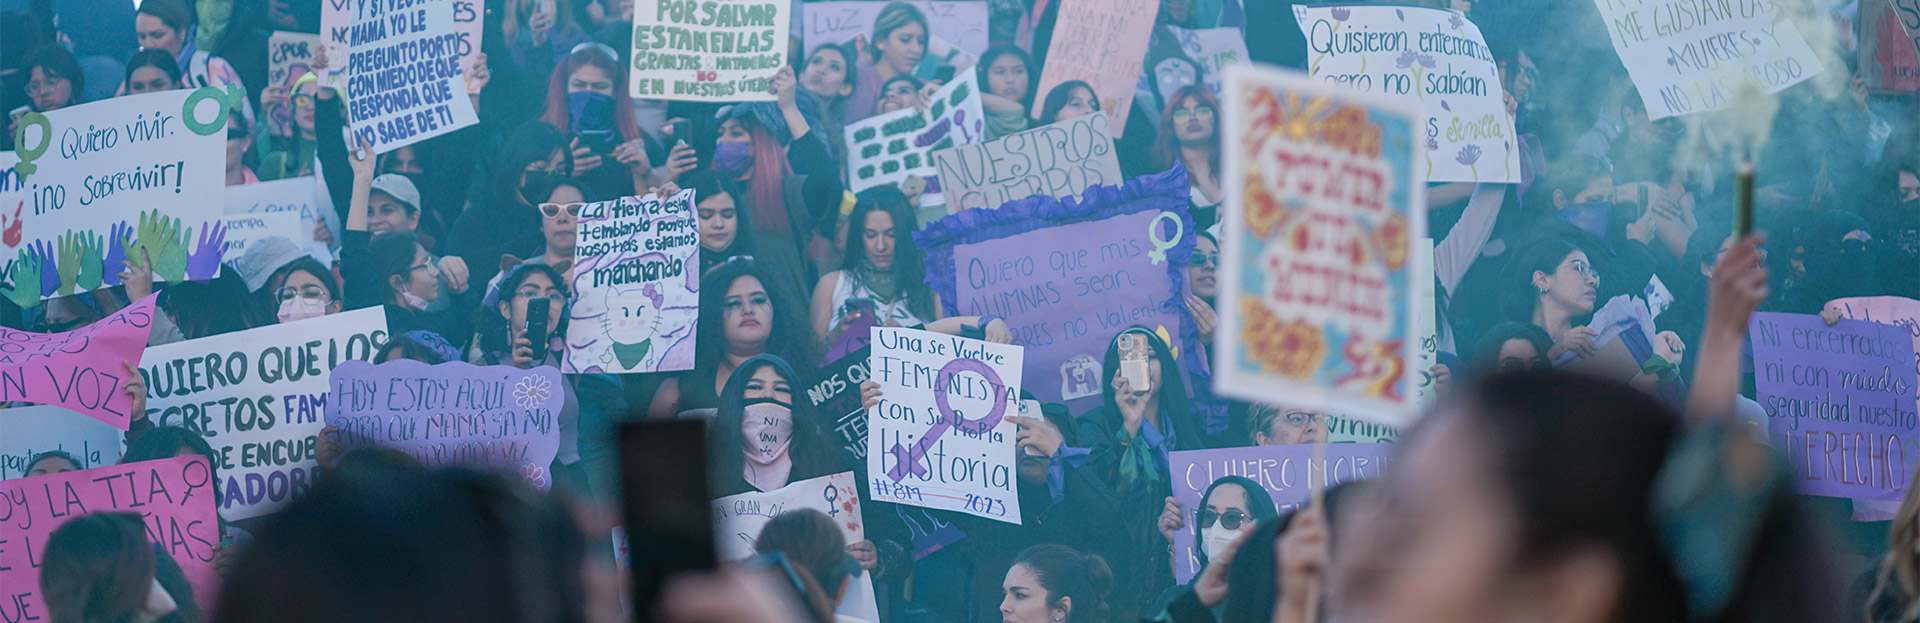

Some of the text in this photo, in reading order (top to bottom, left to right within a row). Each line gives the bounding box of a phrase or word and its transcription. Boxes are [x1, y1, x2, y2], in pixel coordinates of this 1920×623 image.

[350, 11, 387, 48] MAMÁ
[389, 13, 407, 36] YO
[410, 9, 426, 33] LE
[657, 0, 777, 27] POR SALVAR
[813, 9, 863, 35] LUZ
[1614, 10, 1648, 48] ME
[1654, 0, 1732, 37] GUSTAN
[349, 40, 418, 76] PREGUNTO
[419, 35, 444, 60] POR
[443, 33, 459, 55] TI
[634, 25, 775, 53] ESTAN EN LAS
[1310, 19, 1408, 57] Quisieron
[1668, 23, 1781, 76] MUJERES Y
[348, 54, 462, 100] CON MIEDO DE QUE
[633, 50, 702, 71] GRANJAS
[1384, 72, 1410, 95] no
[1426, 62, 1487, 97] sabían
[349, 79, 453, 123] RESPONDA QUE
[639, 78, 664, 95] EN
[673, 79, 736, 97] NUESTROS
[1659, 84, 1693, 114] NO
[61, 111, 175, 160] Quiero vivir.
[354, 104, 454, 148] NO SABE DE TI
[938, 113, 1109, 192] NUESTROS
[581, 193, 690, 219] La tierra está
[576, 231, 697, 256] nosotras estamos
[579, 217, 697, 242] temblando porque
[593, 254, 682, 288] marchando
[968, 238, 1142, 290] Quiero que mis
[971, 269, 1137, 321] ALUMNAS sean
[879, 329, 1004, 365] Una se Vuelve
[1063, 317, 1088, 342] no
[1759, 319, 1907, 365] Ni encerradas
[258, 340, 322, 384] QUE
[878, 356, 1018, 405] FEMINISTA
[1765, 358, 1785, 382] ni
[1792, 364, 1829, 389] con
[1838, 366, 1912, 396] miedo
[44, 365, 124, 417] VOZ
[337, 375, 510, 415] HOY ESTOY AQUÍ
[807, 373, 847, 406] NOS
[334, 415, 383, 445] PARA
[387, 414, 419, 442] QUE
[425, 409, 487, 440] MAMÁ
[523, 408, 552, 437] NO
[764, 416, 779, 427] NI
[1766, 391, 1917, 432] seguridad nuestro
[501, 440, 530, 463] VEZ
[759, 432, 777, 444] UNA
[1785, 429, 1905, 491] DERECHO
[44, 481, 88, 519] LA
[734, 499, 761, 514] GRAN
[872, 478, 923, 502] #8M
